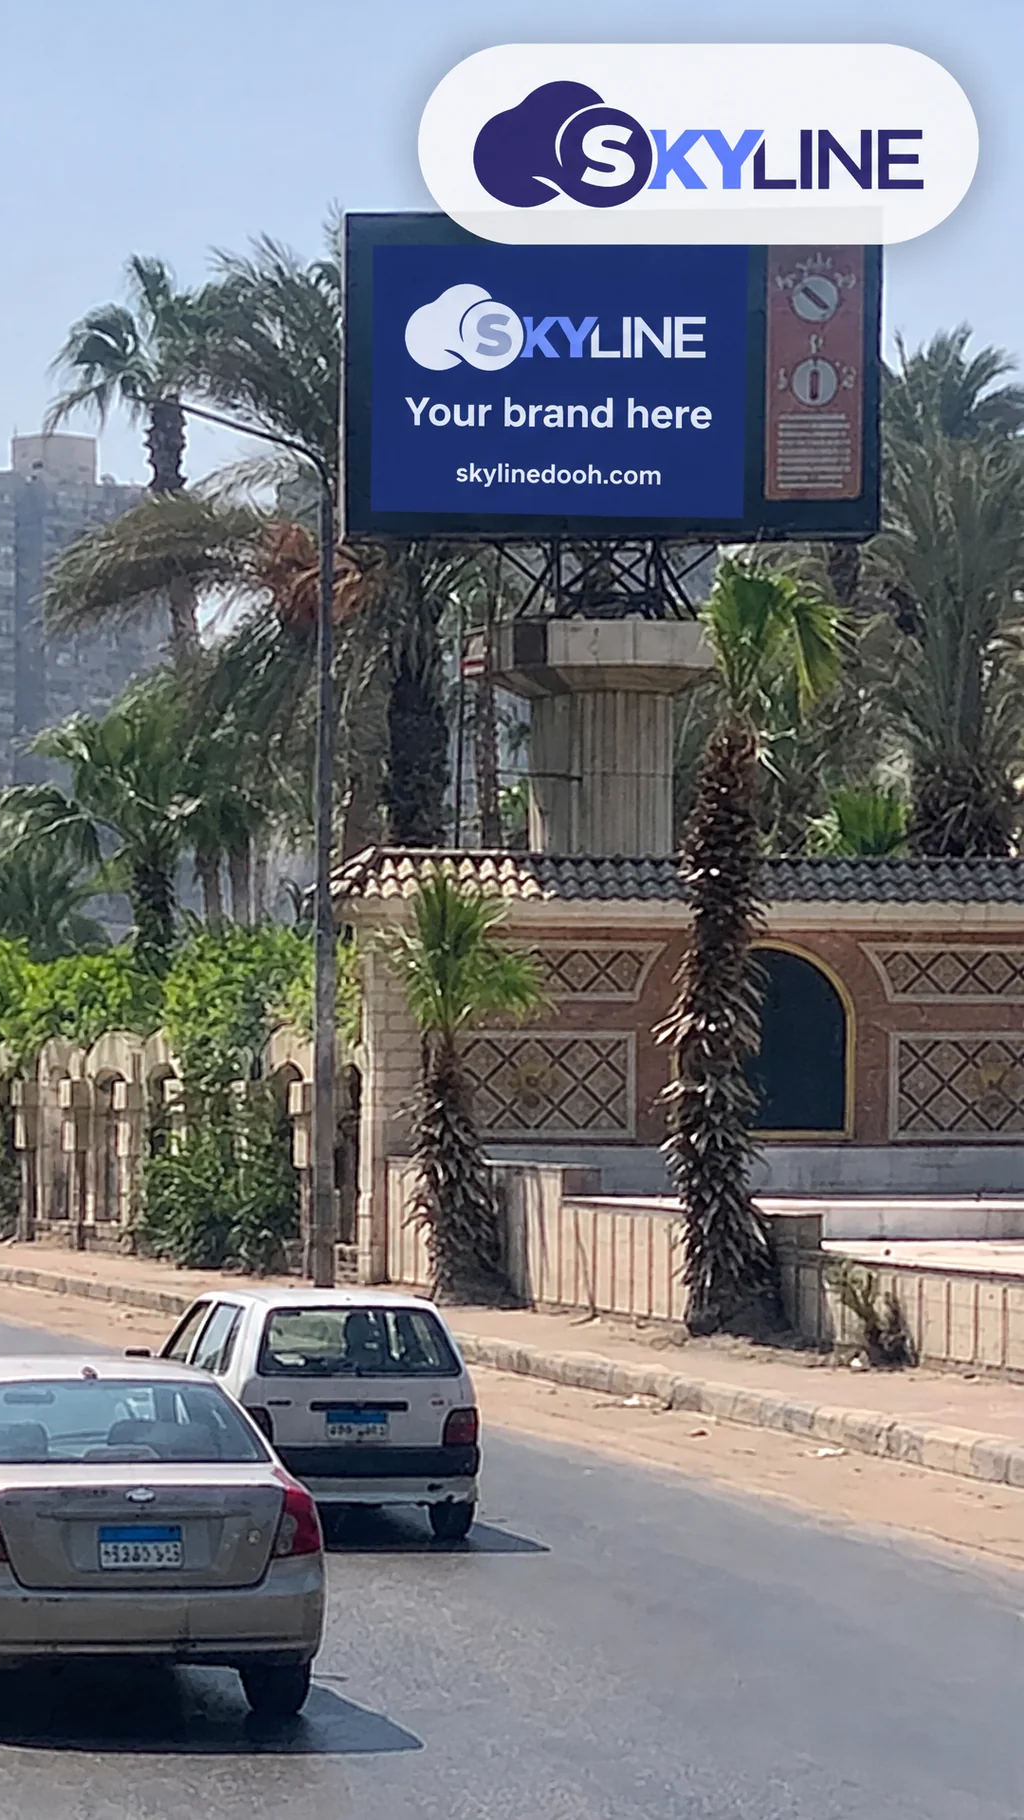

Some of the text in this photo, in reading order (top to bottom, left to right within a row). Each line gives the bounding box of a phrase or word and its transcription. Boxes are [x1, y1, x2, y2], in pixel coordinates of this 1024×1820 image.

[475, 313, 707, 359] SKYLINE
[404, 396, 712, 430] Your brand here
[456, 462, 662, 487] skylinedooh.com
